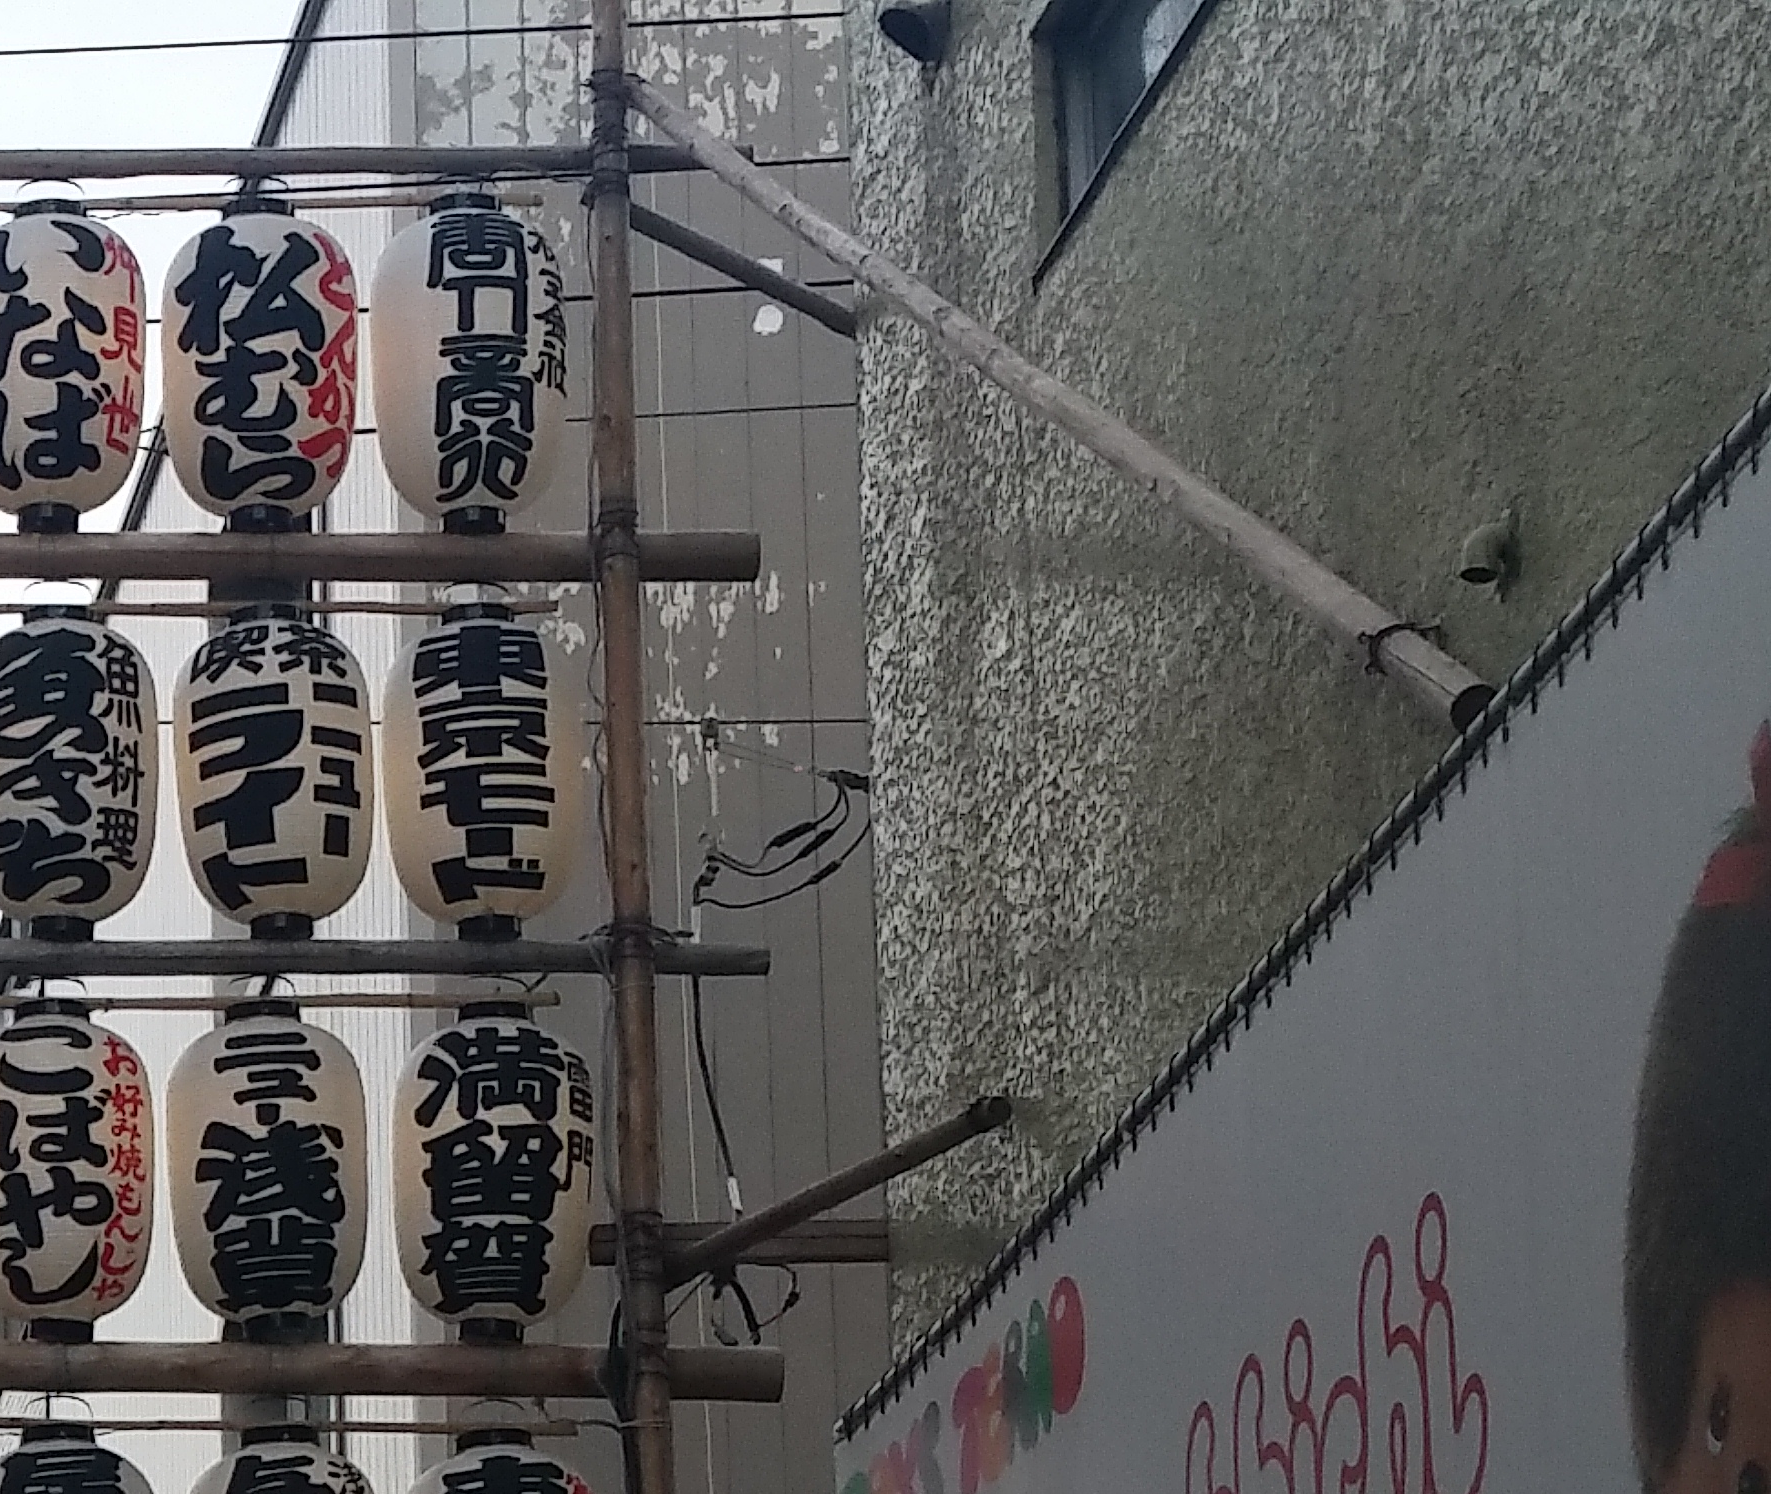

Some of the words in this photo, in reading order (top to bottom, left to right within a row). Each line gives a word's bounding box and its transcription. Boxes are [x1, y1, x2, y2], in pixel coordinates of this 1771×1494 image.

[103, 237, 142, 454] 仲見世
[177, 228, 326, 502] 松むら
[300, 238, 356, 477] とんかつ
[92, 637, 145, 874] 魚料理
[415, 628, 556, 905] 東京モード
[416, 1029, 566, 1317] 満留賀
